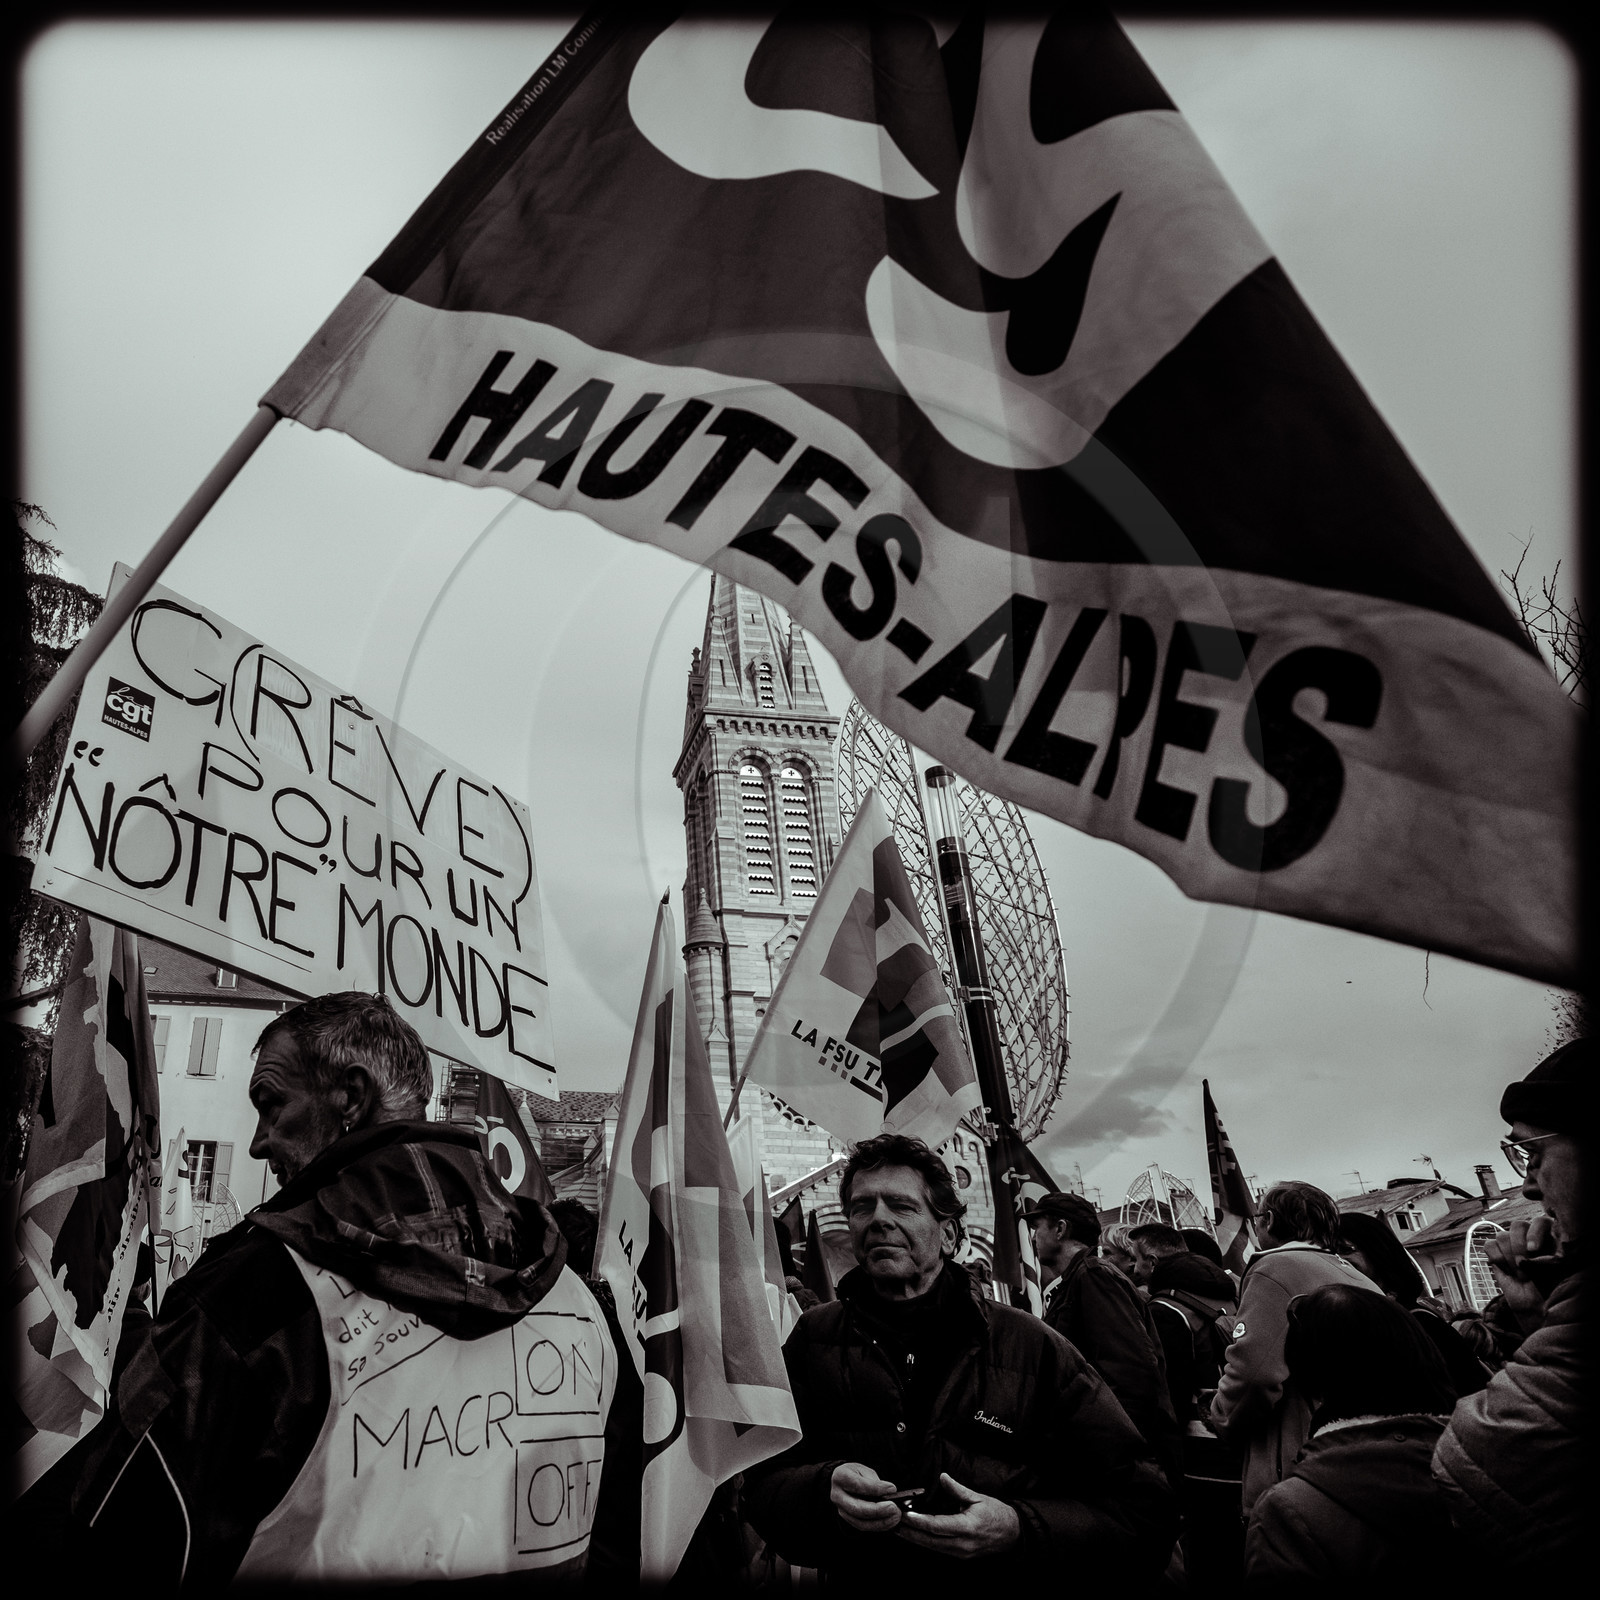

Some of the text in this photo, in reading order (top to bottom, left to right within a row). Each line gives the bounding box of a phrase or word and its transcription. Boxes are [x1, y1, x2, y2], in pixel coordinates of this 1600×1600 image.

[545, 53, 569, 78] LM
[428, 350, 1383, 872] HAUTES-ALPES
[103, 714, 148, 739] HAUTES-ALPES
[106, 694, 153, 726] cgt
[198, 742, 522, 953] POUR UN
[336, 882, 556, 1073] MONDE
[791, 1019, 819, 1047] LA
[821, 1036, 860, 1070] FSU
[618, 1220, 634, 1266] LA
[338, 1309, 380, 1344] doit
[973, 1410, 1014, 1434] Indiana
[527, 1459, 602, 1527] OFF
